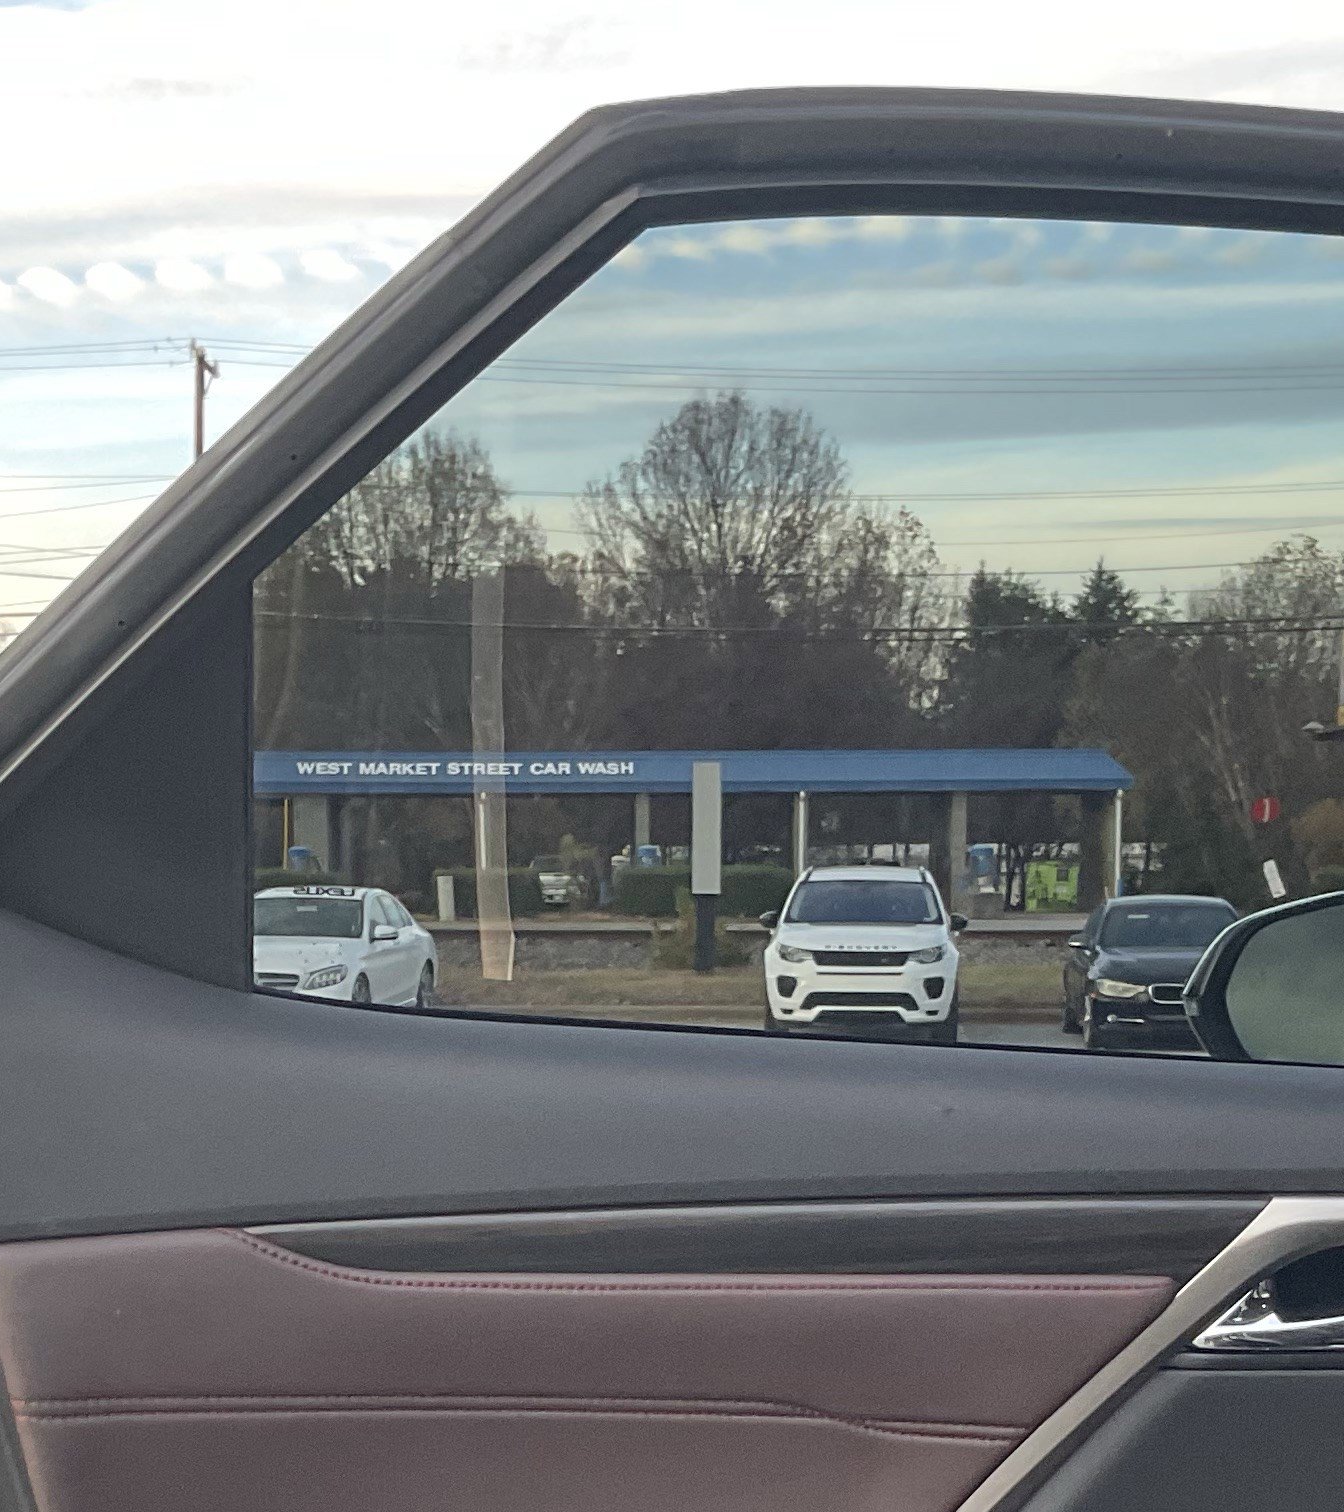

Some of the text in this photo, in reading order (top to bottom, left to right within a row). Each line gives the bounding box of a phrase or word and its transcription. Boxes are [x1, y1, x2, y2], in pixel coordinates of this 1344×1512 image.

[296, 761, 635, 775] WEST MARKET STREET CAR WASH
